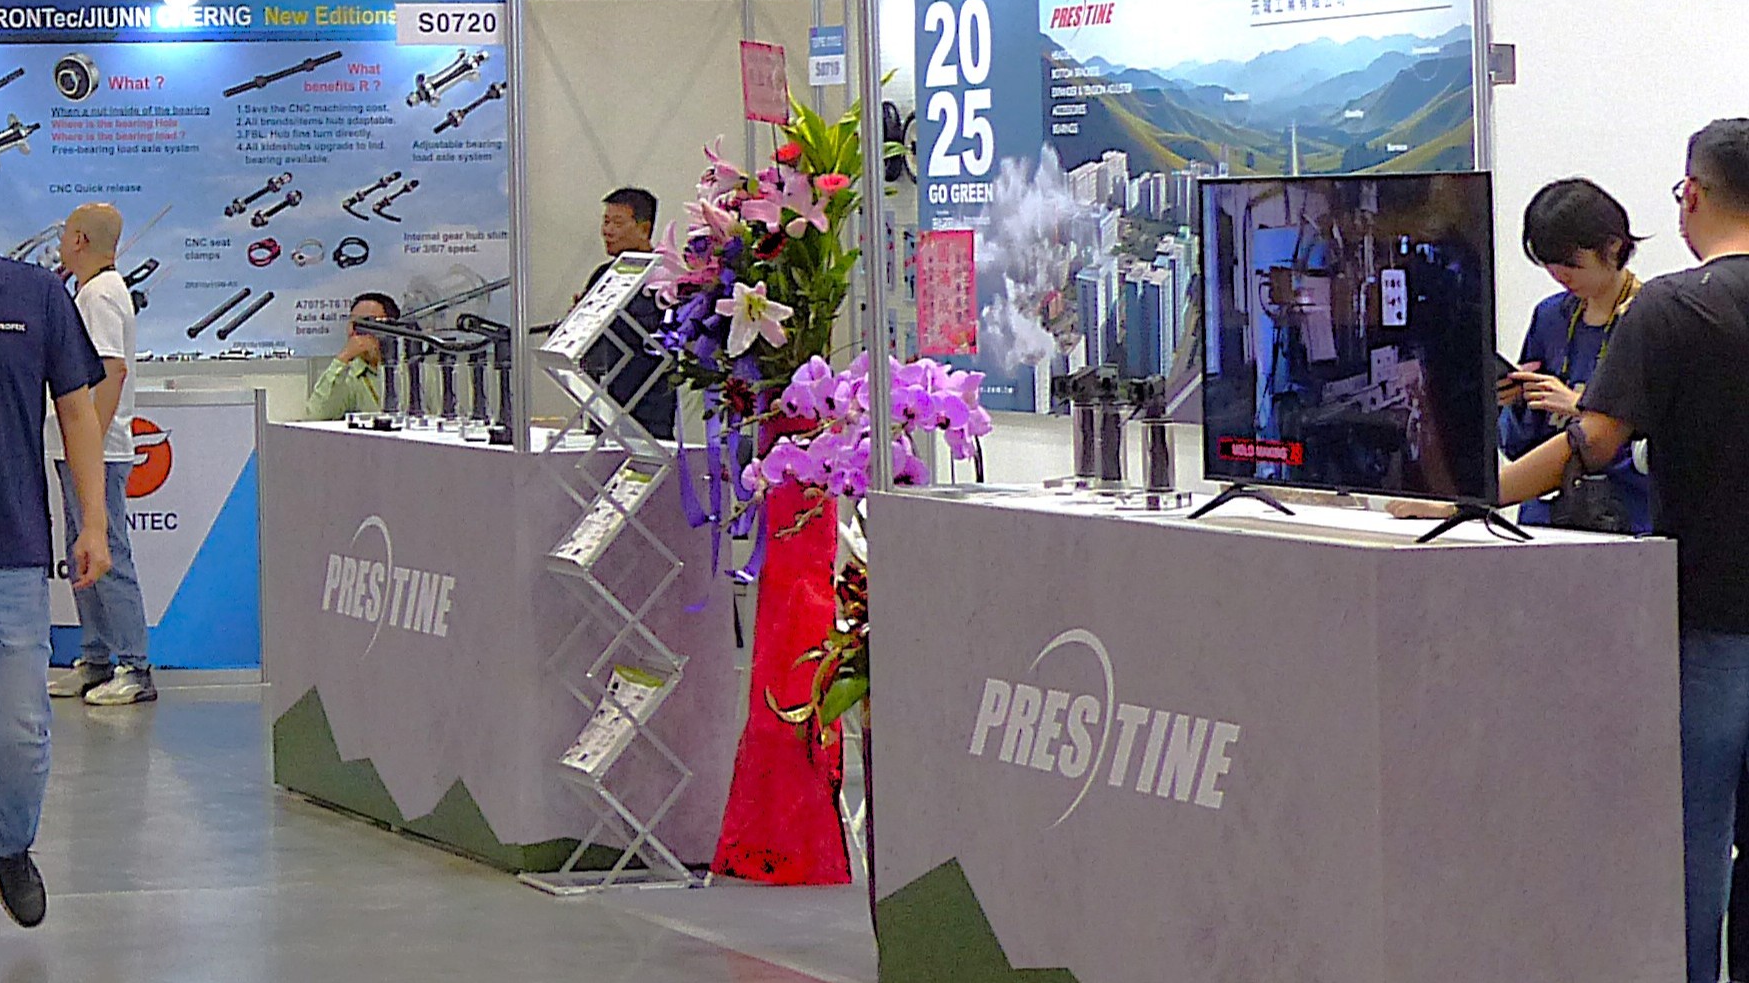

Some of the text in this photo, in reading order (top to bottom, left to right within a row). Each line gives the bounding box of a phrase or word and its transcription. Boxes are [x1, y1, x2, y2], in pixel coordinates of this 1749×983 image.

[264, 6, 309, 26] New
[316, 5, 396, 26] Editions
[1050, 2, 1116, 29] PRESTINE
[418, 11, 497, 33] S0720
[348, 63, 380, 75] What
[108, 75, 151, 90] What
[304, 80, 355, 92] benefits
[142, 105, 153, 116] of
[173, 105, 210, 117] bearing
[270, 104, 286, 113] the
[289, 103, 311, 113] CNC
[313, 104, 363, 114] machining
[51, 119, 83, 129] Where
[115, 119, 152, 129] bearing
[51, 132, 83, 141] Where
[116, 131, 152, 142] bearing
[926, 89, 994, 177] 25
[164, 143, 199, 154] system
[413, 140, 503, 151] Adjustable bearing
[245, 155, 281, 165] bearing
[458, 153, 492, 163] system
[49, 183, 141, 194] CNC Quick release
[928, 182, 994, 204] GO GREEN
[404, 232, 440, 241] Internal
[185, 238, 231, 247] CNC seat
[404, 244, 420, 254] For
[185, 251, 221, 261] clamps
[126, 512, 178, 531] NTEC
[322, 552, 456, 638] PRESTINE
[968, 677, 1241, 809] PRESTINE
